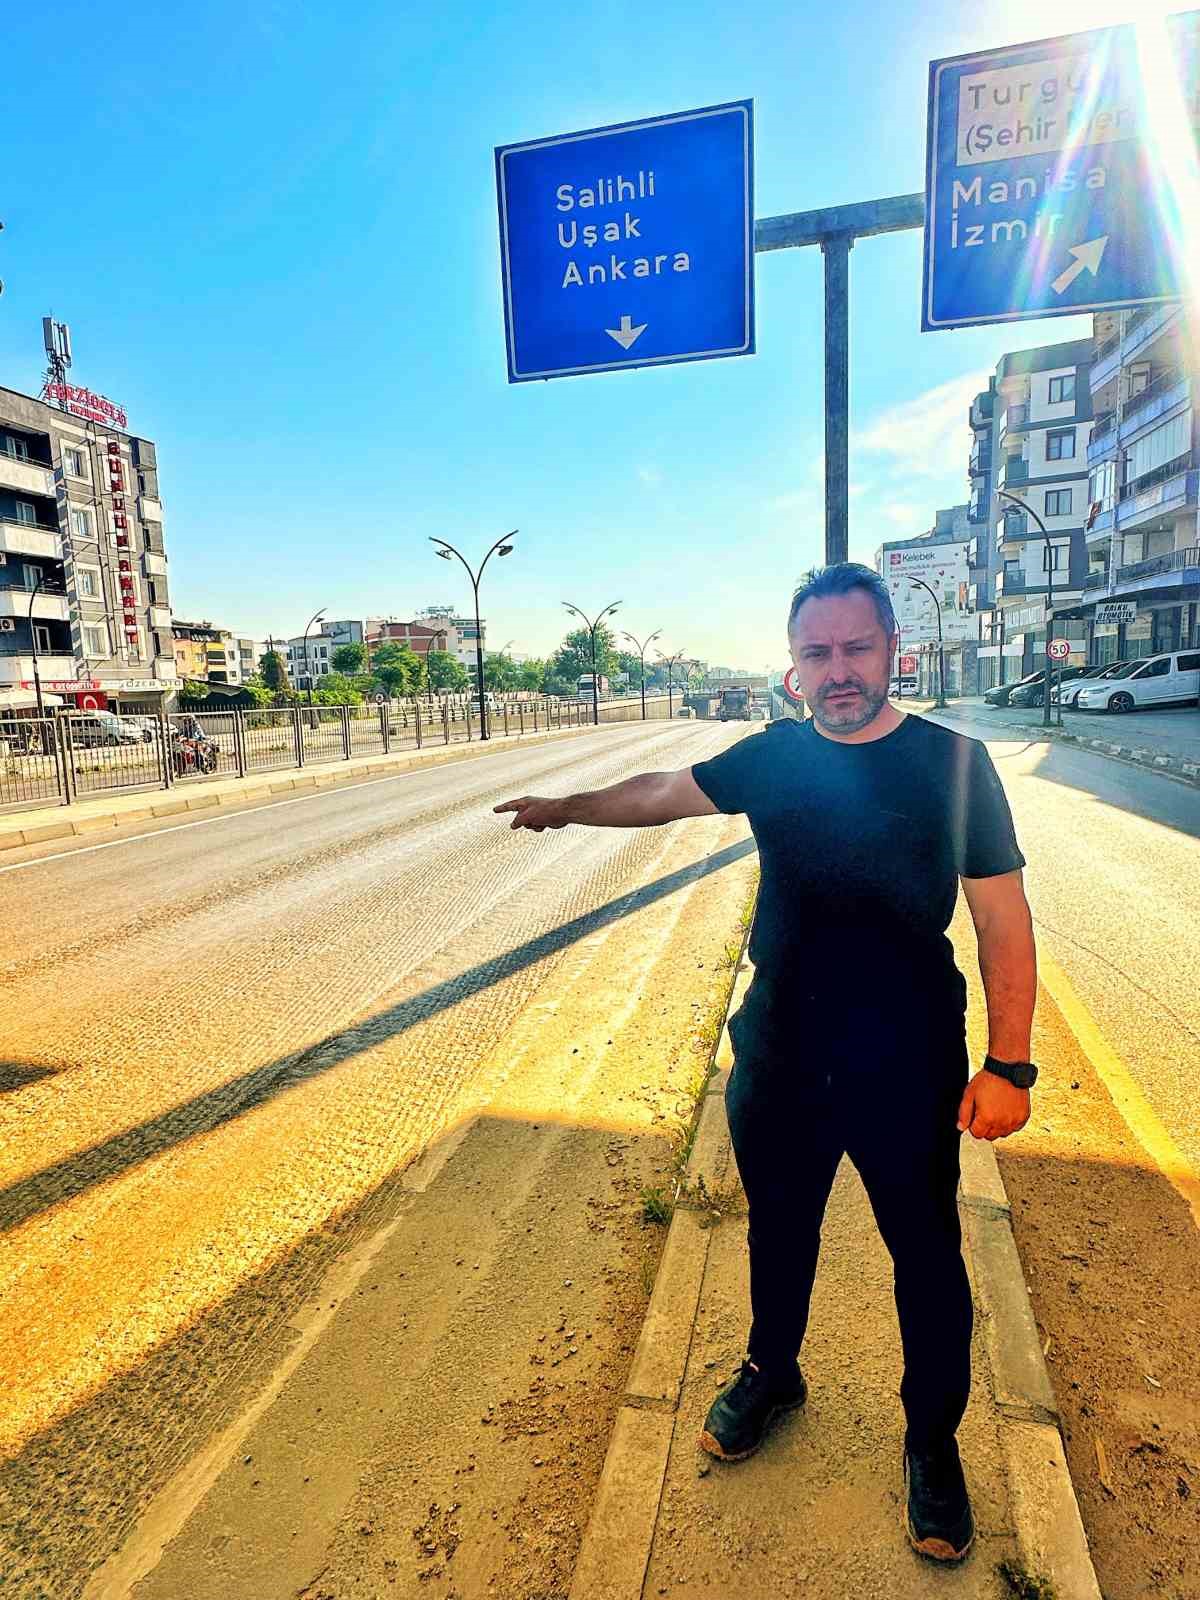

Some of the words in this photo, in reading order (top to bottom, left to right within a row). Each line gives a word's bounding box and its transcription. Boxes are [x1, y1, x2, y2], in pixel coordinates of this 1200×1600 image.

[556, 170, 655, 212] Salihli
[952, 167, 1106, 210] Manisa
[558, 212, 641, 248] Uşak
[951, 210, 1064, 249] İzmir
[561, 252, 690, 288] Ankara
[902, 551, 936, 561] Kelebek
[1052, 645, 1067, 655] 50
